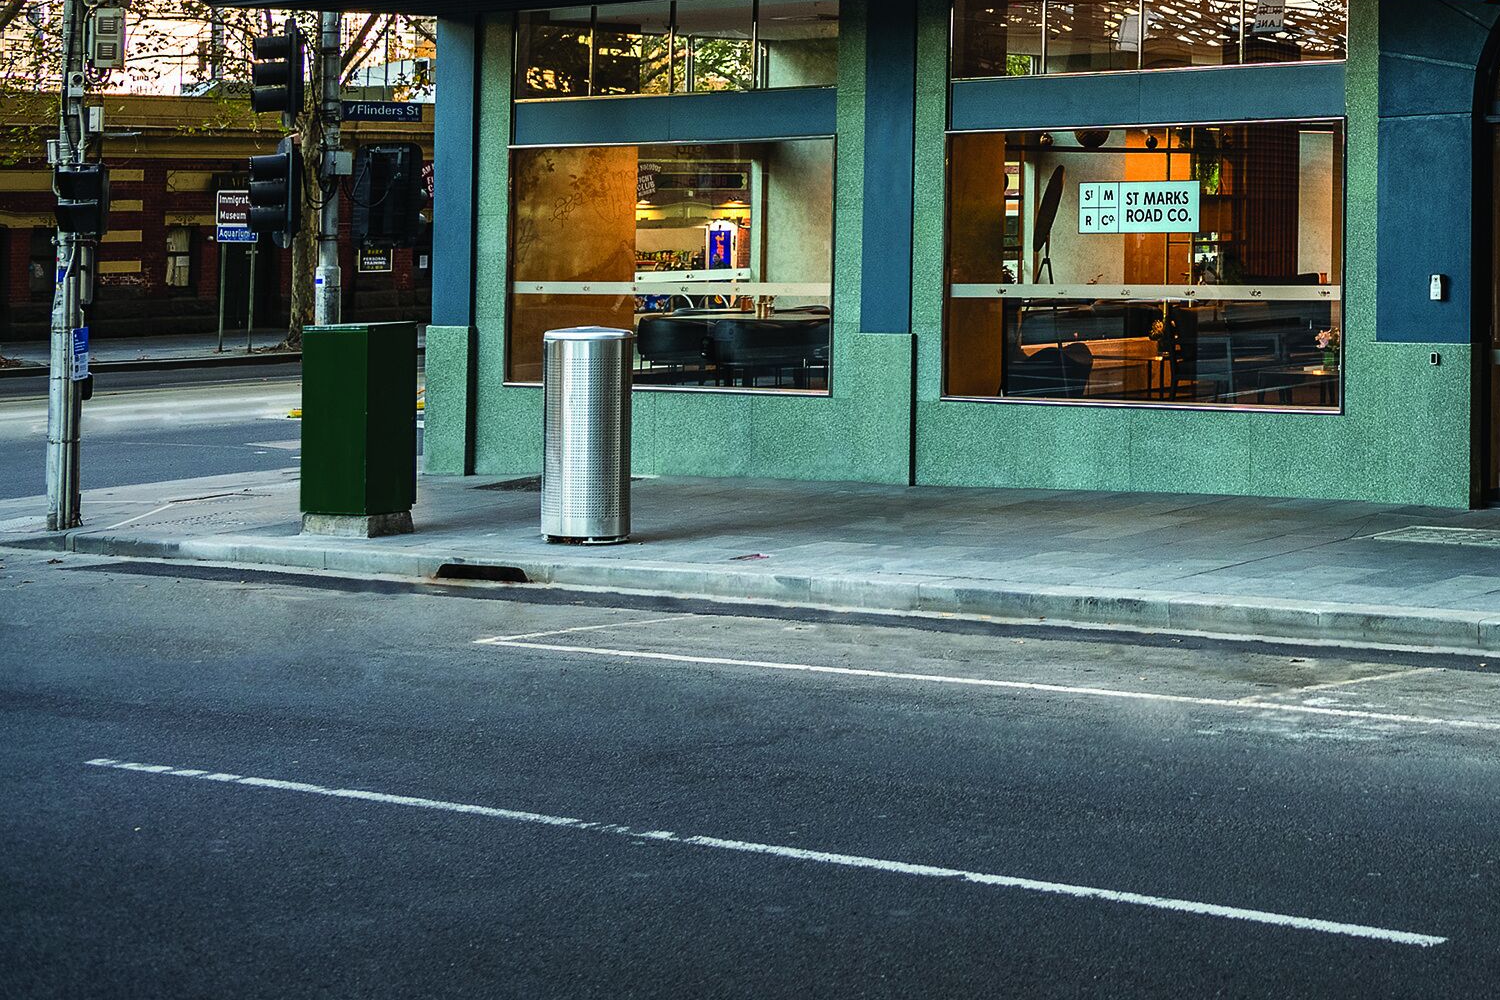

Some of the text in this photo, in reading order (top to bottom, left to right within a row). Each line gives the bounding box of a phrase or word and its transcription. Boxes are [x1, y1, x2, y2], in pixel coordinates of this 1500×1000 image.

[357, 104, 419, 115] Flinders St
[219, 195, 249, 207] Immigrat
[1103, 190, 1114, 201] M
[1126, 191, 1189, 205] ST MARKS
[219, 210, 247, 220] Museum
[1085, 215, 1092, 226] R
[1126, 208, 1192, 222] ROAD CO.
[218, 228, 251, 239] Aquarium
